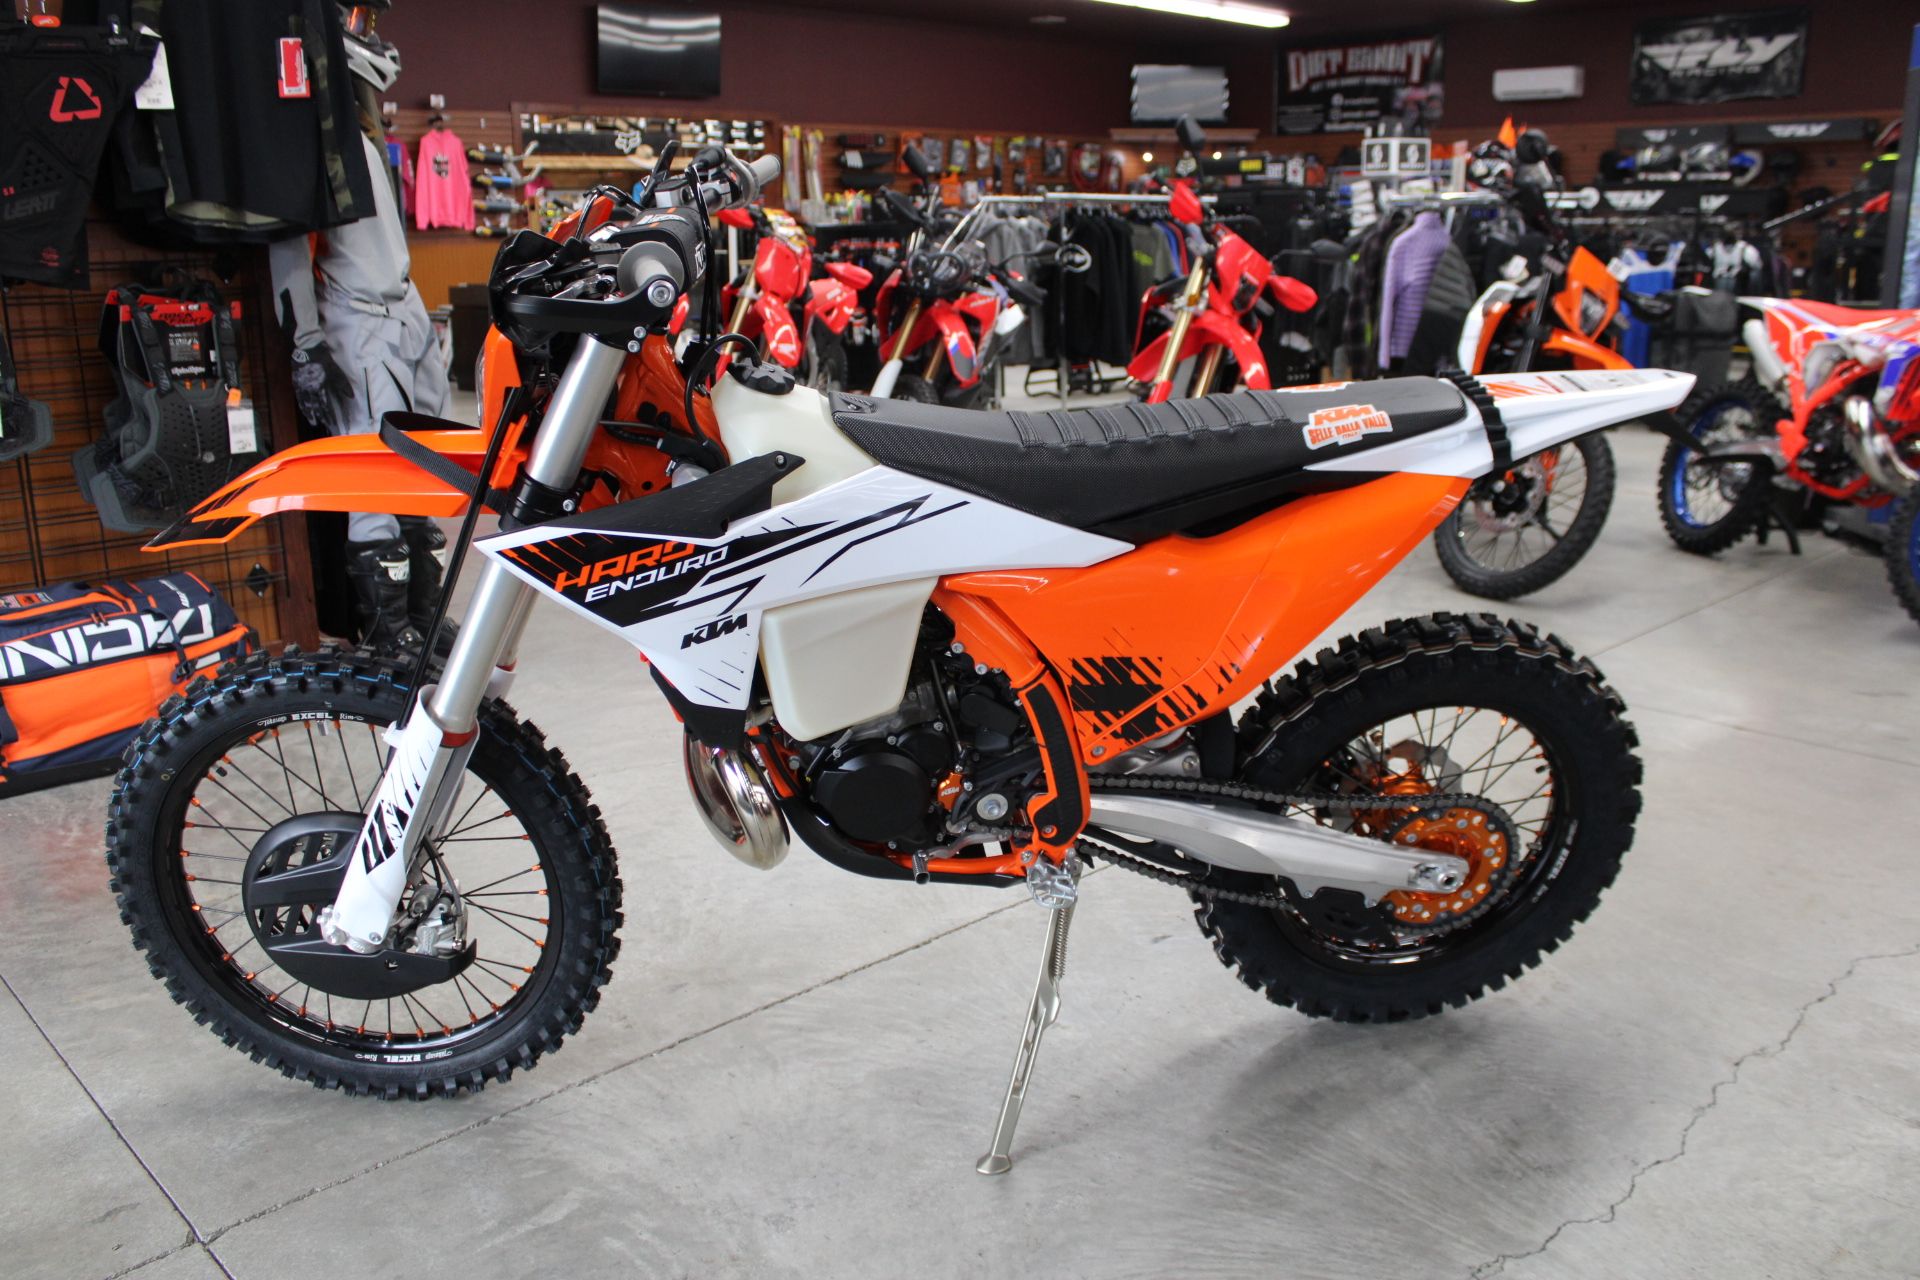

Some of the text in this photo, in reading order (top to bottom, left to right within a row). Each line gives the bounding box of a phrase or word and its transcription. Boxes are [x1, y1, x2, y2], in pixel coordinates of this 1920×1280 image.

[1288, 39, 1434, 92] DIRT BANDIT
[1641, 32, 1801, 71] FLY
[1603, 189, 1666, 211] FLY
[1313, 406, 1372, 425] KTM
[554, 541, 695, 593] HARD
[585, 545, 729, 603] ENDURO
[0, 604, 215, 680] RACIN
[681, 613, 748, 650] KTM
[290, 712, 334, 721] EXCEL
[383, 1054, 422, 1063] EXCEL
